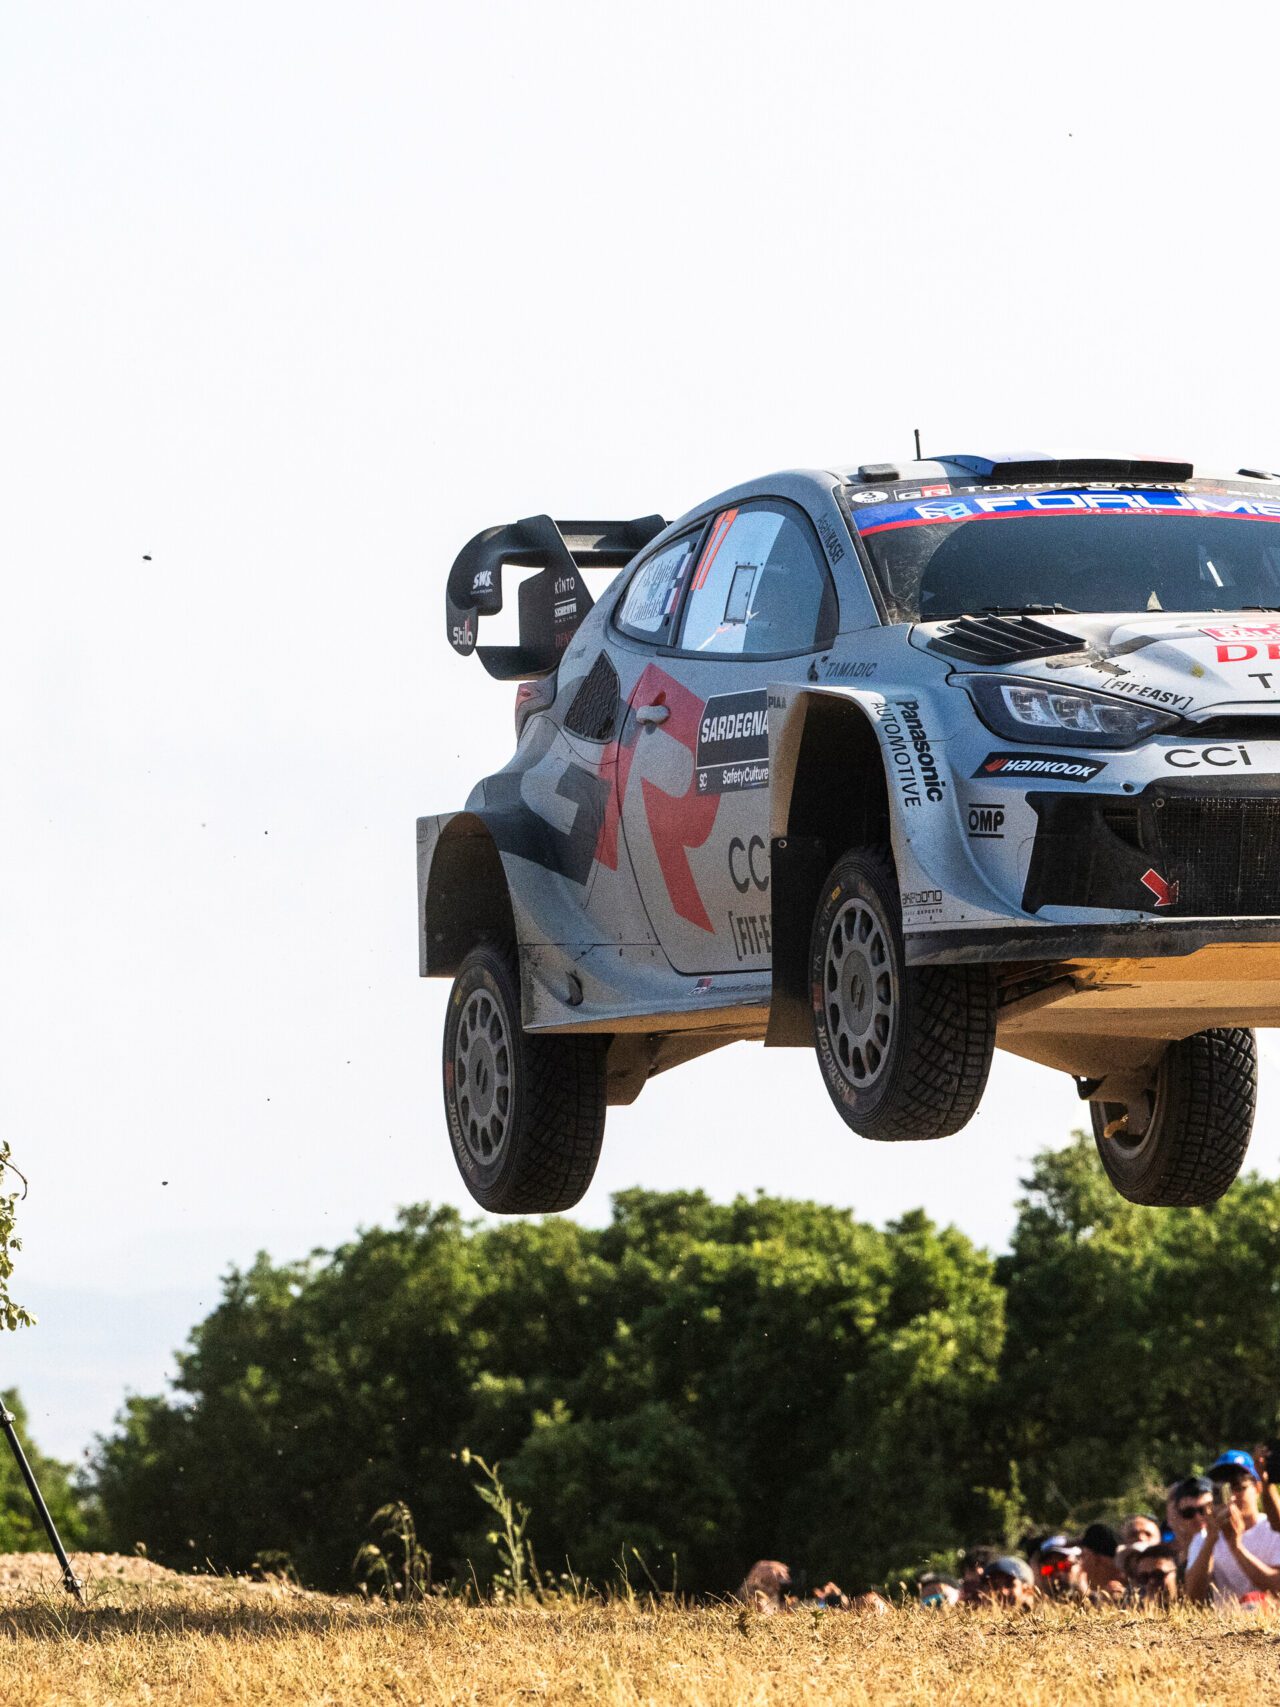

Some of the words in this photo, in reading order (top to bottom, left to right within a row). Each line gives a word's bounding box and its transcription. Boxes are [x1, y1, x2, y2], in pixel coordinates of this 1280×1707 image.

[897, 487, 949, 500] GR
[959, 482, 1082, 493] TOYOTA
[825, 662, 877, 678] TAMADIC
[701, 709, 769, 743] SARDEGNA
[871, 701, 922, 808] AUTOMOTIVE
[895, 700, 943, 802] Panasonic
[722, 766, 769, 787] SafetyCulture
[968, 809, 1005, 832] OMP
